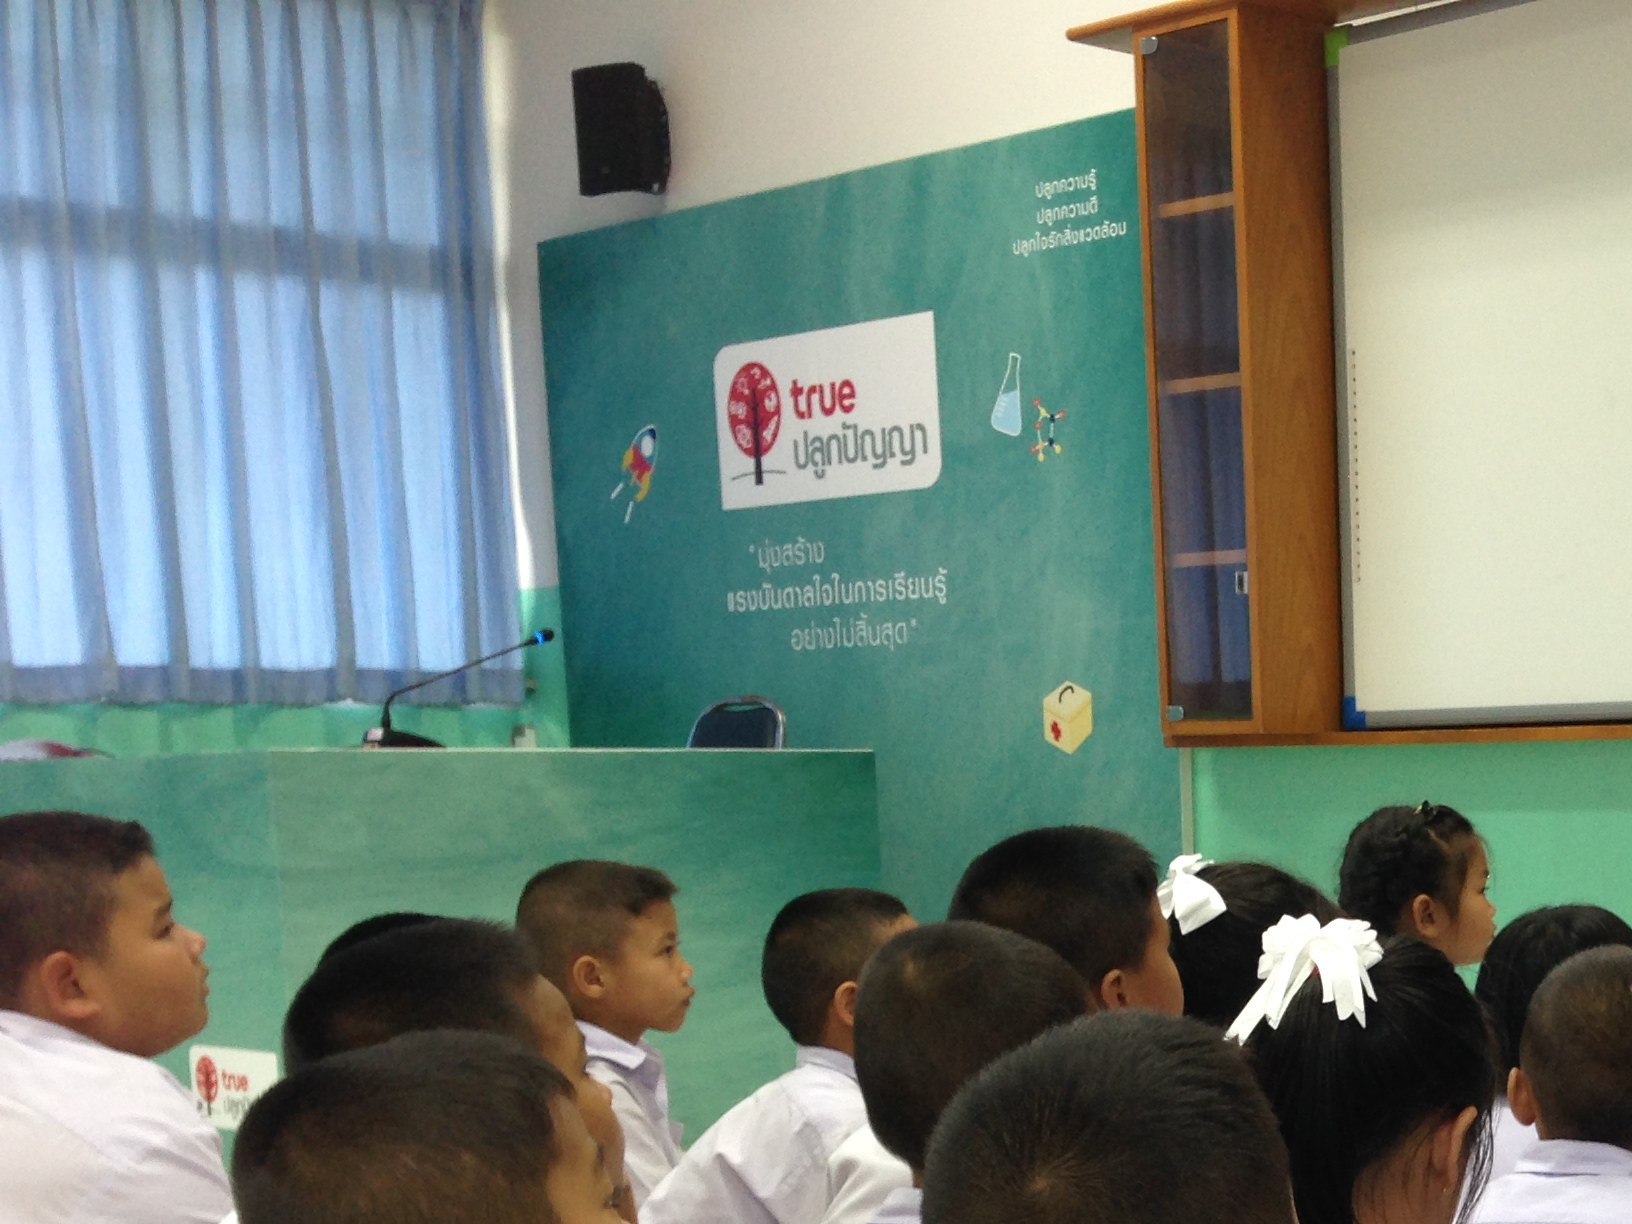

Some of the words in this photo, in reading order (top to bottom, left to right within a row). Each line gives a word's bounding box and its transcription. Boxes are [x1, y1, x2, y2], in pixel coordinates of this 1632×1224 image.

[1035, 167, 1098, 200] ปลูกความรู้
[1036, 195, 1099, 226] ปลูกความดี
[1012, 219, 1127, 258] ปลูกใจรักสิ่งแวดล้อม
[789, 378, 857, 421] true
[793, 421, 929, 480] ปลูกปัญญา
[726, 566, 949, 614] แรงบันดาลใจในการเรียนรู้
